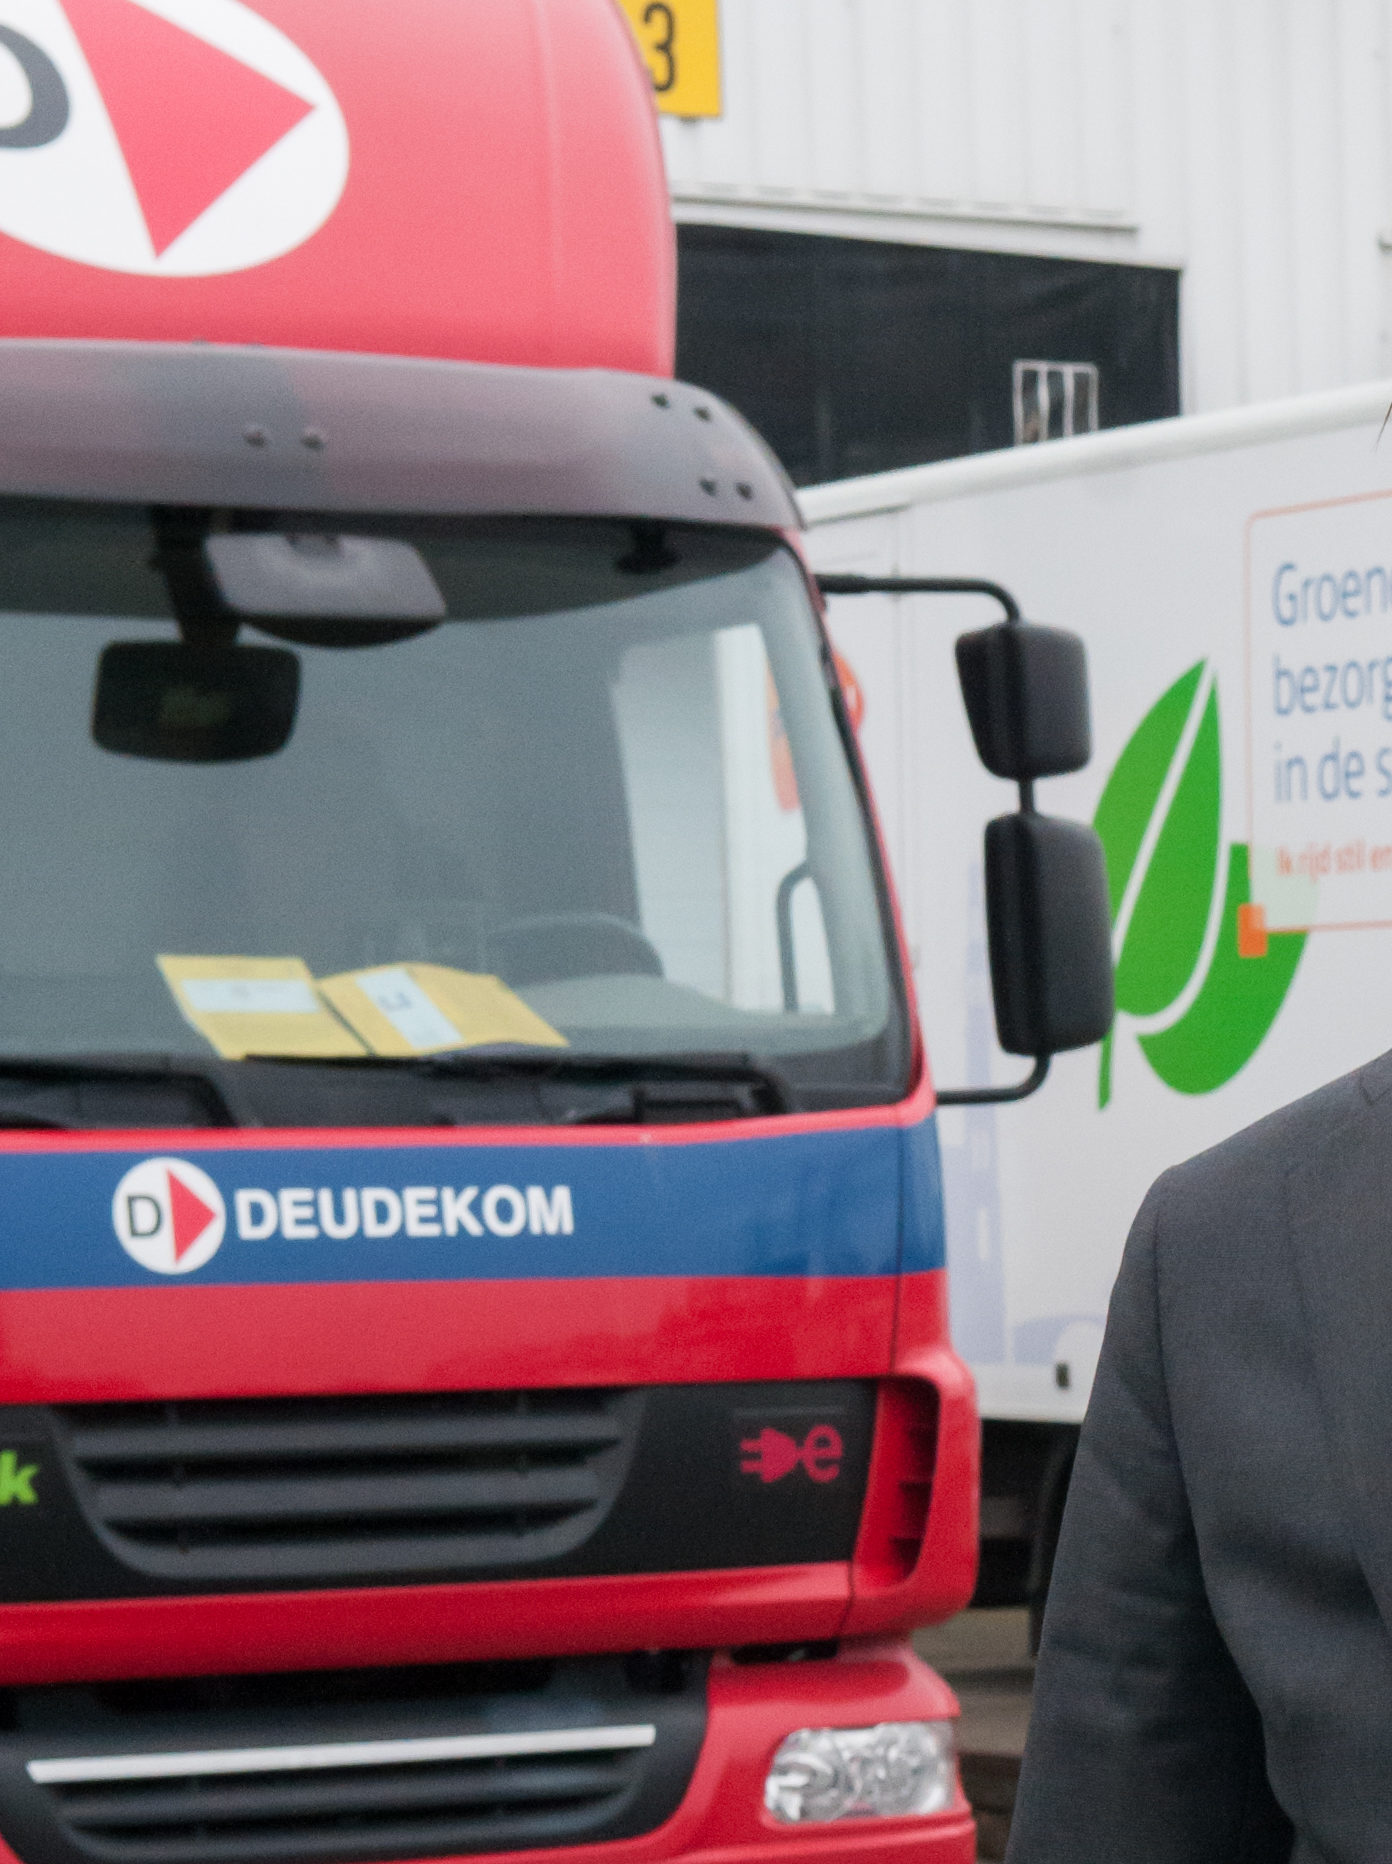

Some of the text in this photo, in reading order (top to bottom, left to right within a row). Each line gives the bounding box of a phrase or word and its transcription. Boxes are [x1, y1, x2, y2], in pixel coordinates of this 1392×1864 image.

[643, 2, 676, 92] 3
[1274, 739, 1309, 803] in
[1317, 734, 1366, 801] de
[126, 1184, 575, 1241] D DEUDEKOM
